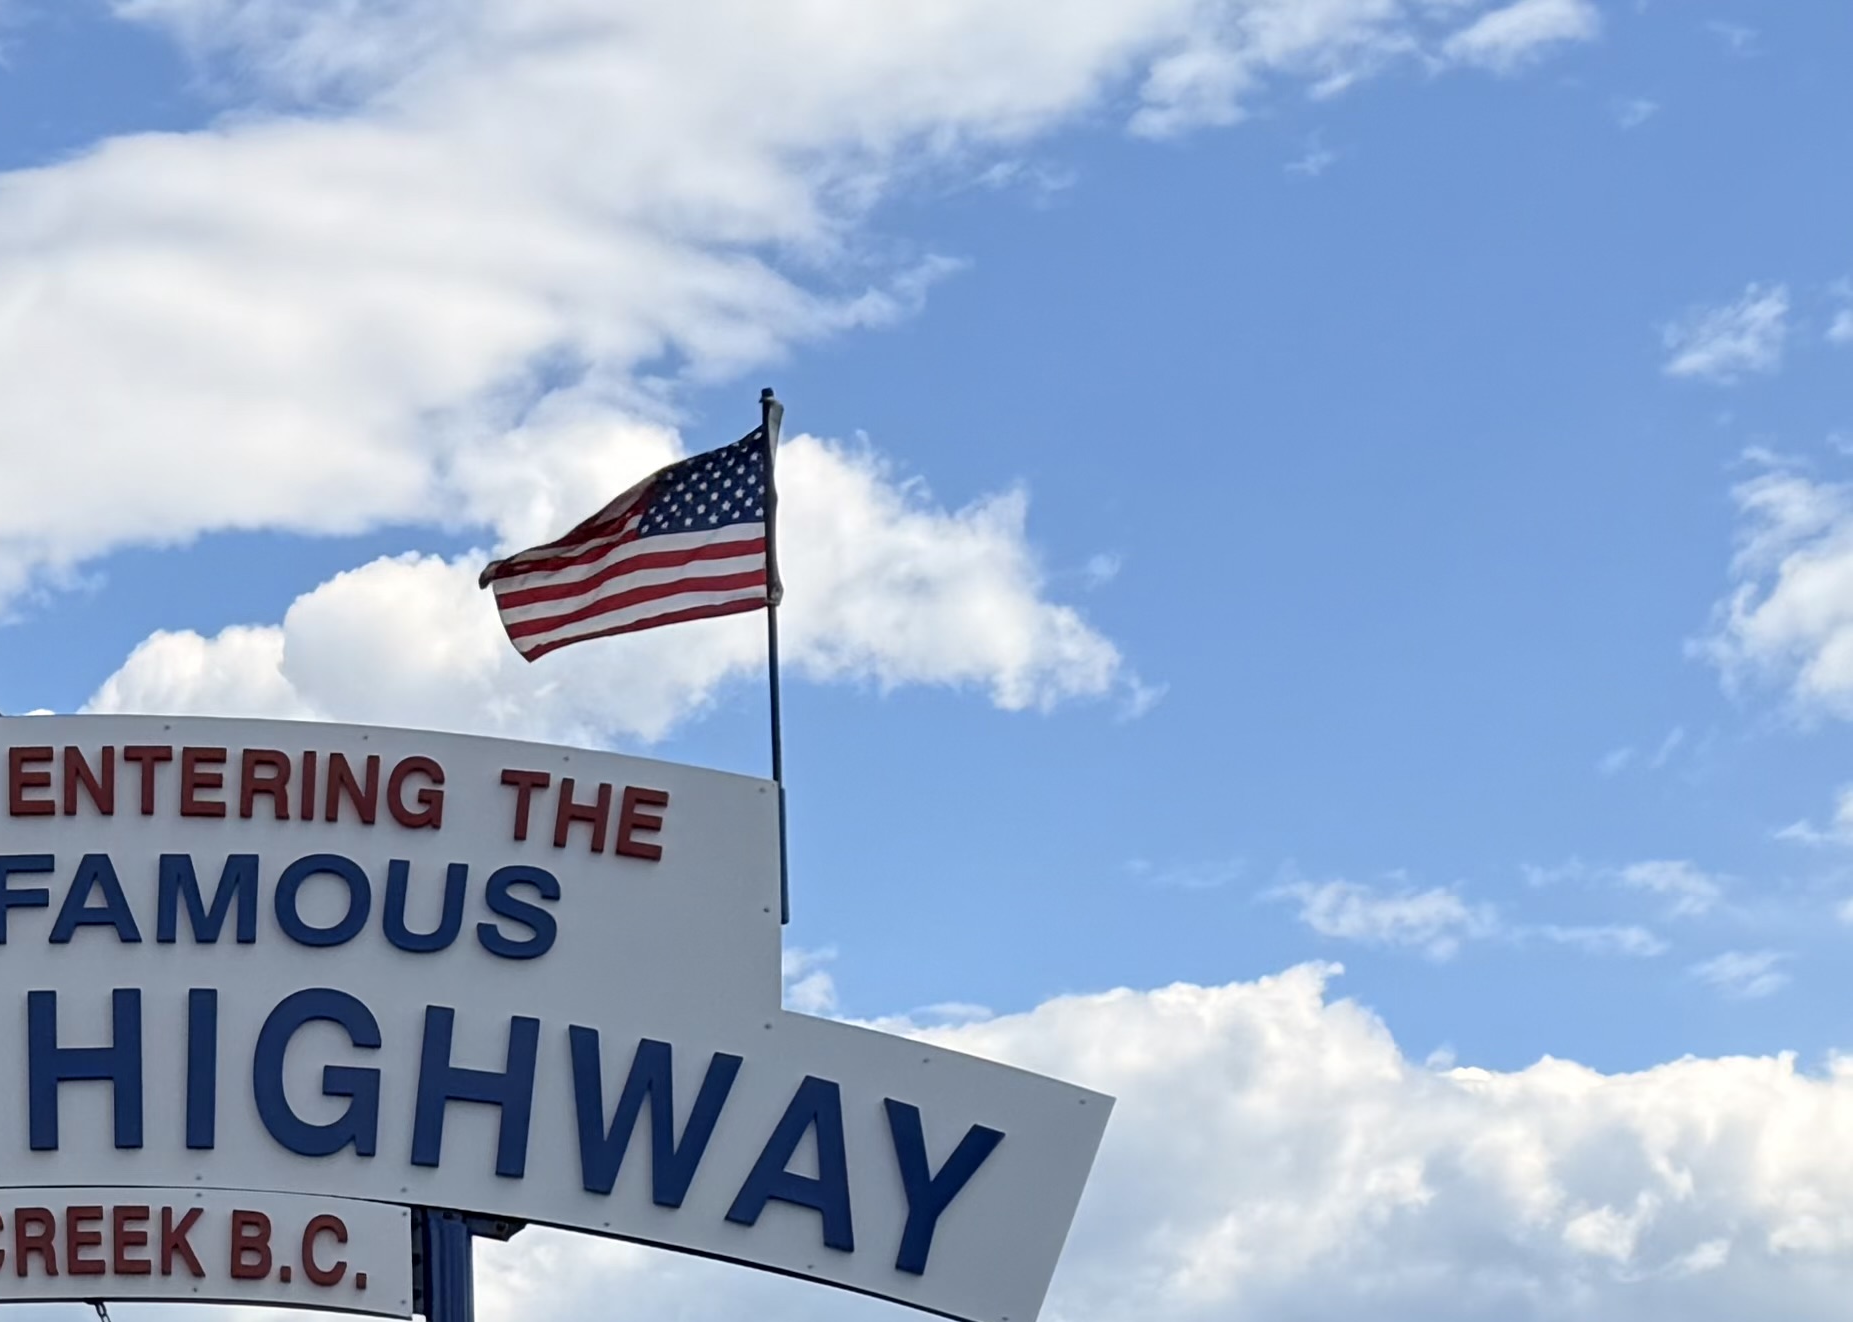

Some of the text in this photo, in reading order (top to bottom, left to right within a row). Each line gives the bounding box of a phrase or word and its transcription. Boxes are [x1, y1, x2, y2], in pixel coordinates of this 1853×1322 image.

[9, 746, 445, 829] ENTERING
[501, 770, 669, 861] THE
[25, 987, 1006, 1276] HIGHWAY
[230, 1210, 367, 1288] B.C.
